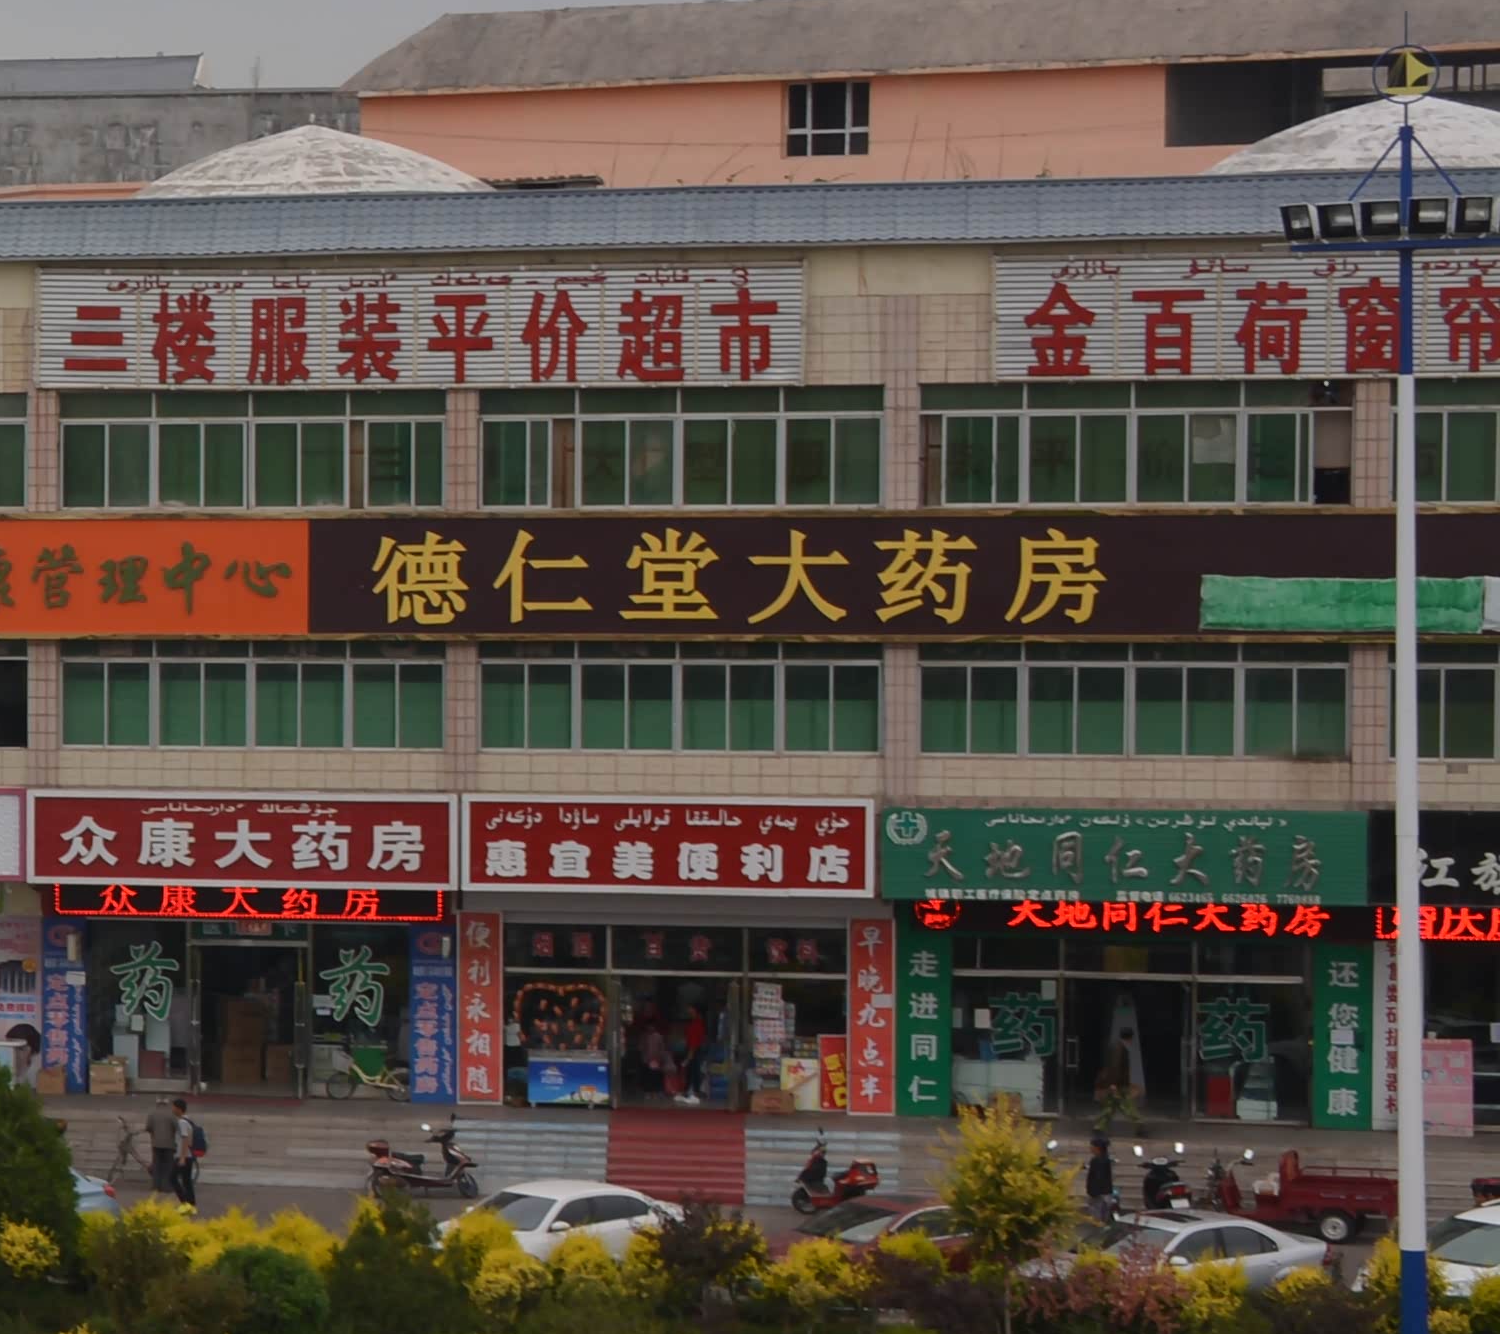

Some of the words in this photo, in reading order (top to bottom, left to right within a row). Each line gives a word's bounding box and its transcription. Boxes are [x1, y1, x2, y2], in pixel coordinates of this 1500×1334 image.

[63, 287, 779, 385] 三楼服装平价超市
[1023, 277, 1500, 377] 金百荷窗帘
[371, 526, 1108, 625] 德仁堂大药房
[57, 815, 425, 872] 众康大药房
[485, 839, 851, 884] 惠宜美便利店
[924, 830, 1324, 891] 天地同仁大药房
[110, 940, 181, 1022] 药
[319, 945, 391, 1028] 药
[464, 919, 494, 1096] 便利永相随
[908, 950, 940, 1104] 走进同仁
[987, 991, 1058, 1060] 药
[1196, 996, 1271, 1062] 药
[1326, 960, 1360, 1118] 还您健康
